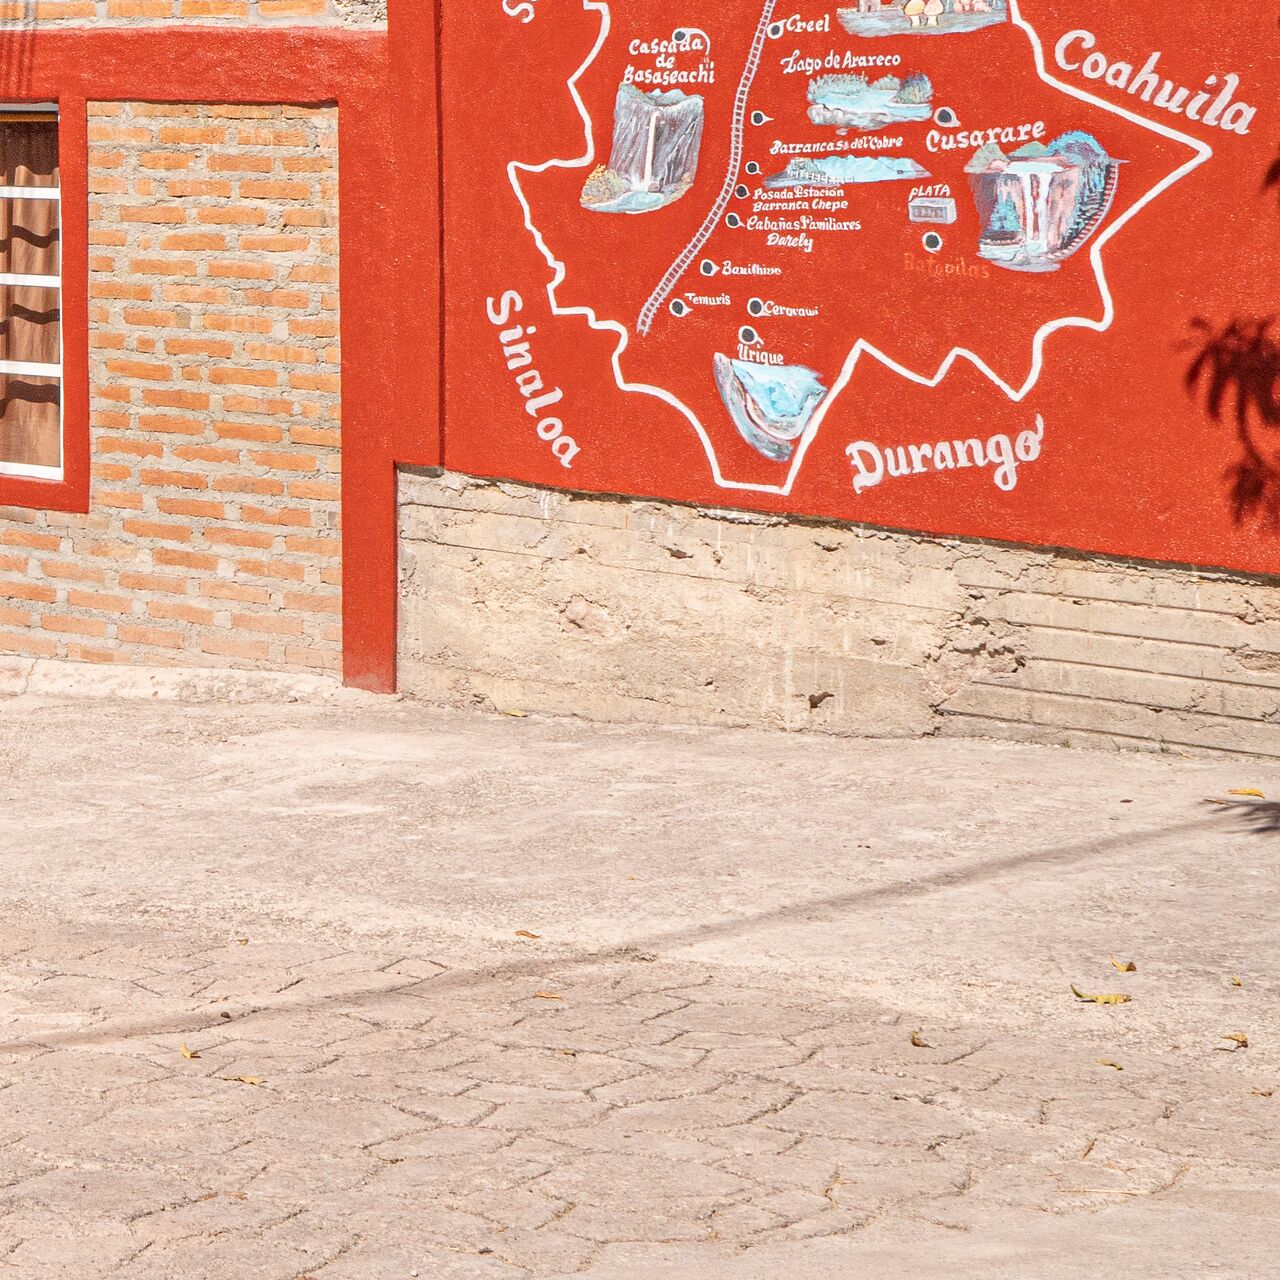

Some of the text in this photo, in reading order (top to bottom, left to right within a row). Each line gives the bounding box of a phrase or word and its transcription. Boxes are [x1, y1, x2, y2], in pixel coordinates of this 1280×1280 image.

[786, 14, 830, 33] Creel
[628, 37, 704, 55] Cascada
[655, 53, 675, 69] de
[780, 49, 901, 75] Lago de Arareco
[623, 61, 715, 85] Basaseachi
[1054, 29, 1257, 135] Coahuila
[850, 137, 868, 149] del
[868, 136, 903, 150] Cobre
[925, 120, 1046, 153] Cusarare
[752, 188, 793, 200] Posada
[752, 198, 848, 212] Barranca Chepe
[746, 215, 861, 231] Cabañas Familiares
[767, 232, 813, 253] Darely
[737, 342, 784, 365] Urique
[486, 290, 581, 469] Sinaloa
[845, 413, 1045, 495] Durango
